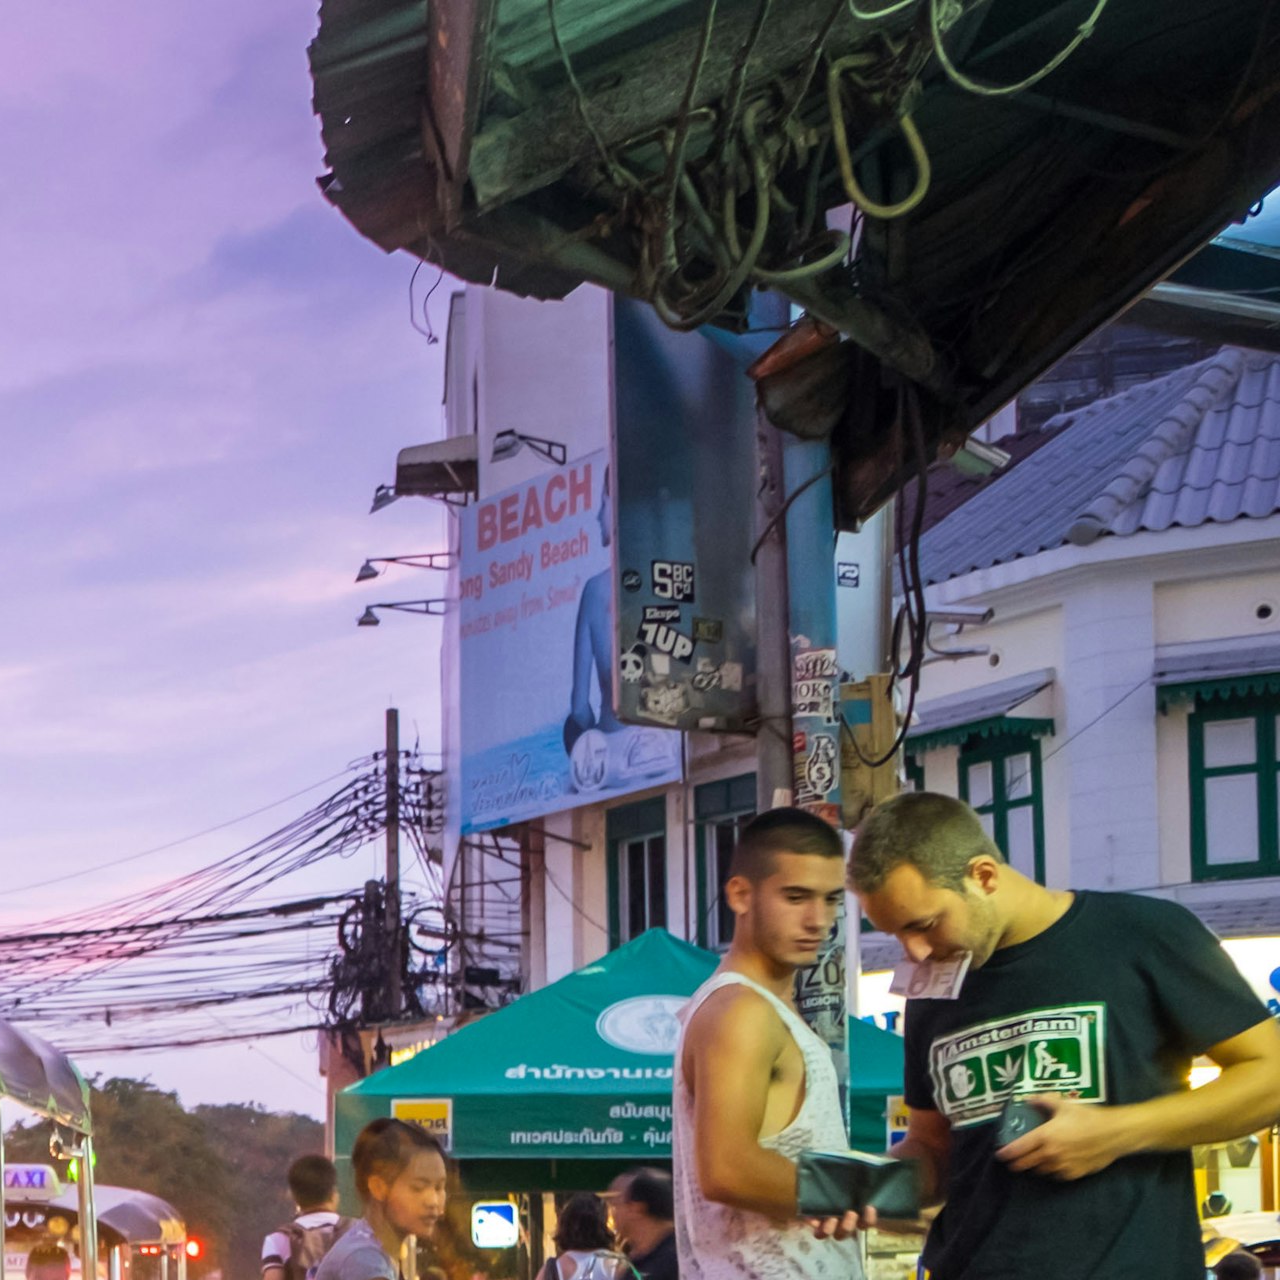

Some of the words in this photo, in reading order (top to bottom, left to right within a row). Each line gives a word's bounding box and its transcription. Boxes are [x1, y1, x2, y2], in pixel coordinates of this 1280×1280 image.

[476, 463, 593, 553] BEACH
[489, 550, 533, 590] Sandy
[540, 528, 589, 571] Beach
[641, 622, 693, 660] 1UP
[945, 1016, 1077, 1060] Amsterdam
